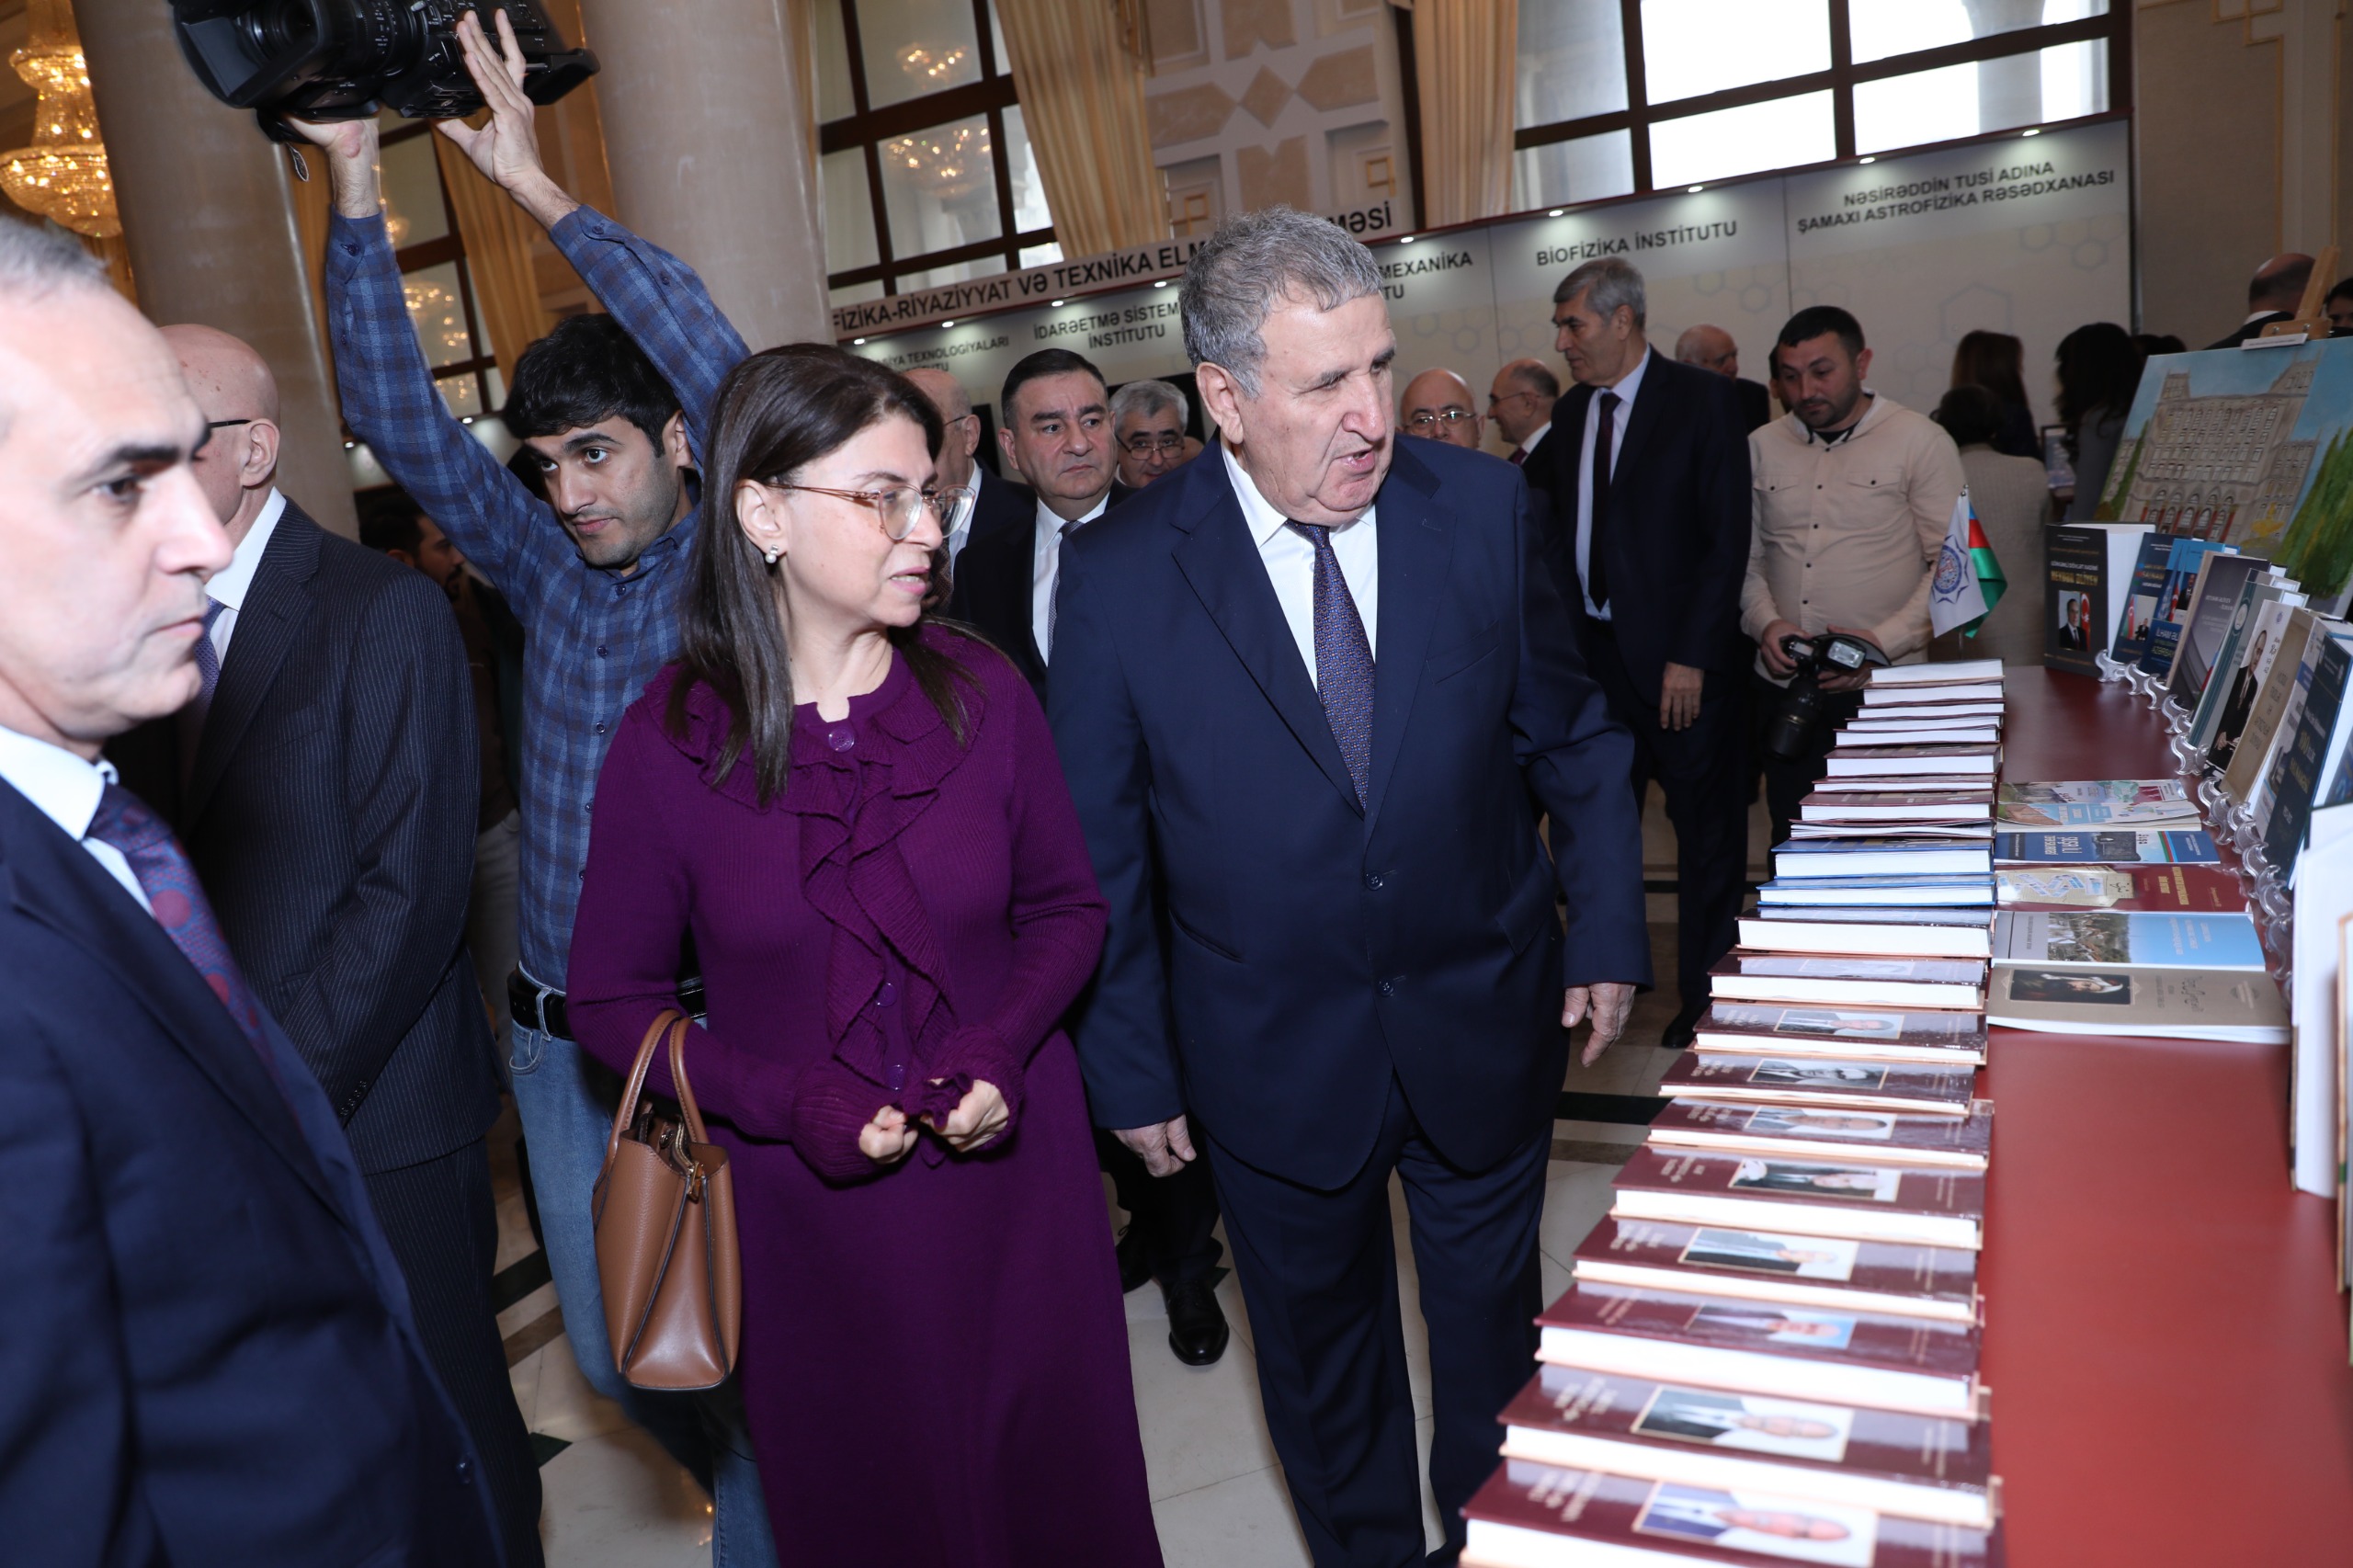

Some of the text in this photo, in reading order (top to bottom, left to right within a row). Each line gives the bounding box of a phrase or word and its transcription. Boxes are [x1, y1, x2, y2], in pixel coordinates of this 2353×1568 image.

[1797, 169, 2115, 235] ŞAMAXI ASTROFİZİKA RƏSƏDXANASI
[1845, 161, 2055, 207] NƏSİRƏDDİN TUSİ ADINA
[1536, 220, 1738, 267] BİOFİZİKA İNSTİTUTU
[1017, 273, 1048, 296] VƏ
[1053, 252, 1154, 290] TEXNİKA
[1379, 251, 1473, 279] MEXANİKA
[1034, 312, 1120, 340] İDARƏETMƏ
[1088, 324, 1166, 349] İNSTİTUTU
[908, 335, 1009, 365] TEXNOLOGİYALARI
